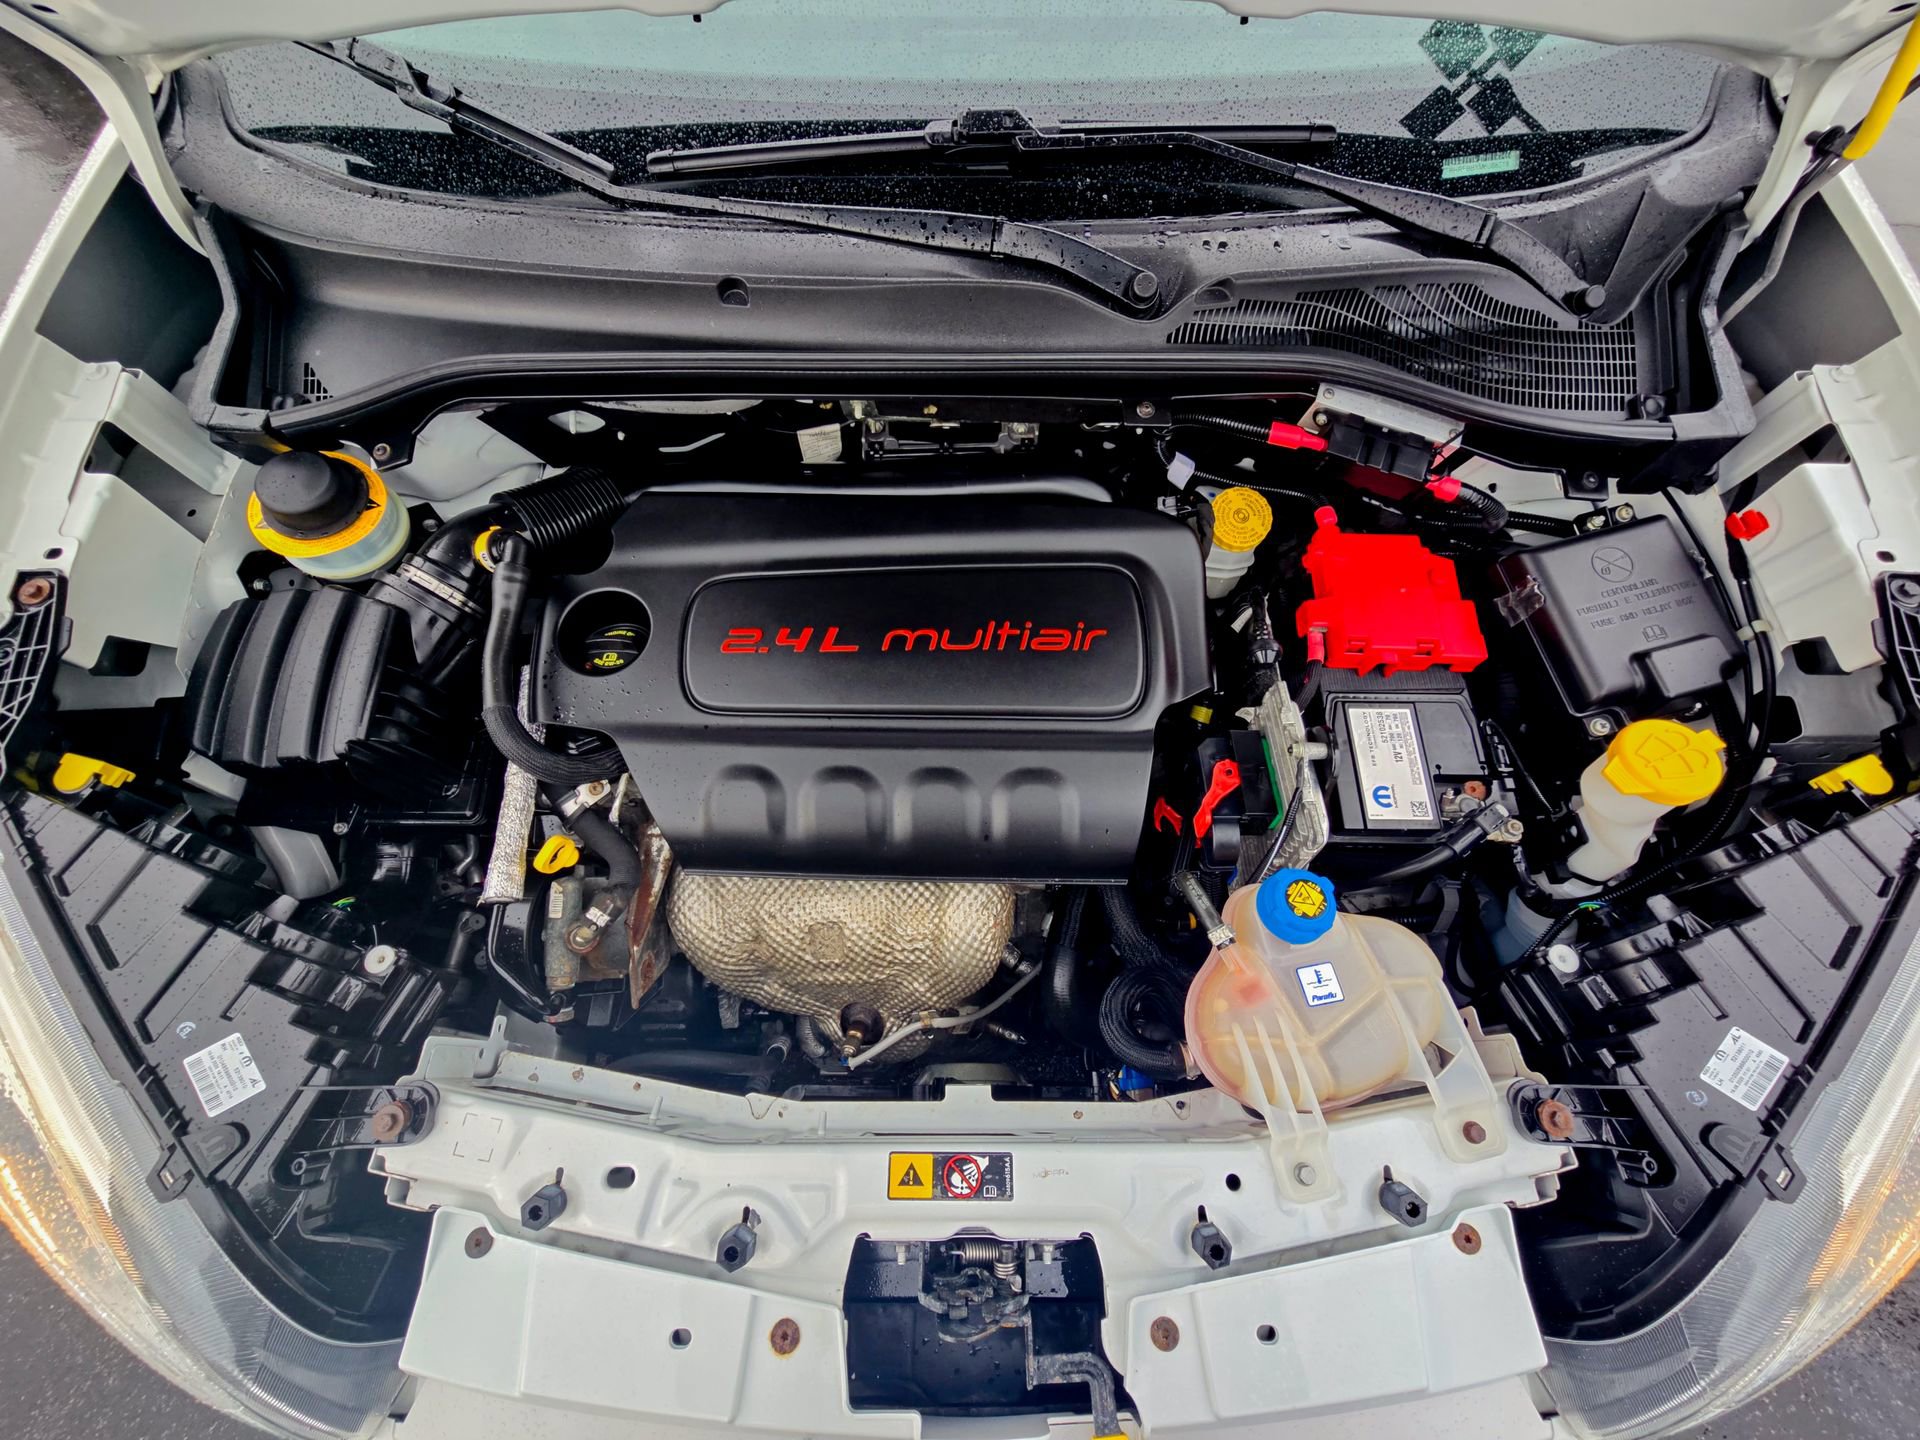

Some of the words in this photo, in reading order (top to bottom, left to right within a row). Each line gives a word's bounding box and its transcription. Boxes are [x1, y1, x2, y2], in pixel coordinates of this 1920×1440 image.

[1590, 617, 1616, 629] FUSE
[1619, 610, 1639, 622] AND
[1642, 603, 1672, 616] RELAY
[881, 620, 1107, 652] multiair
[1362, 711, 1374, 752] TECHNOLOGY
[1376, 711, 1388, 743] 52102538
[1393, 751, 1403, 763] 12V
[1312, 991, 1337, 1003] Paraflu
